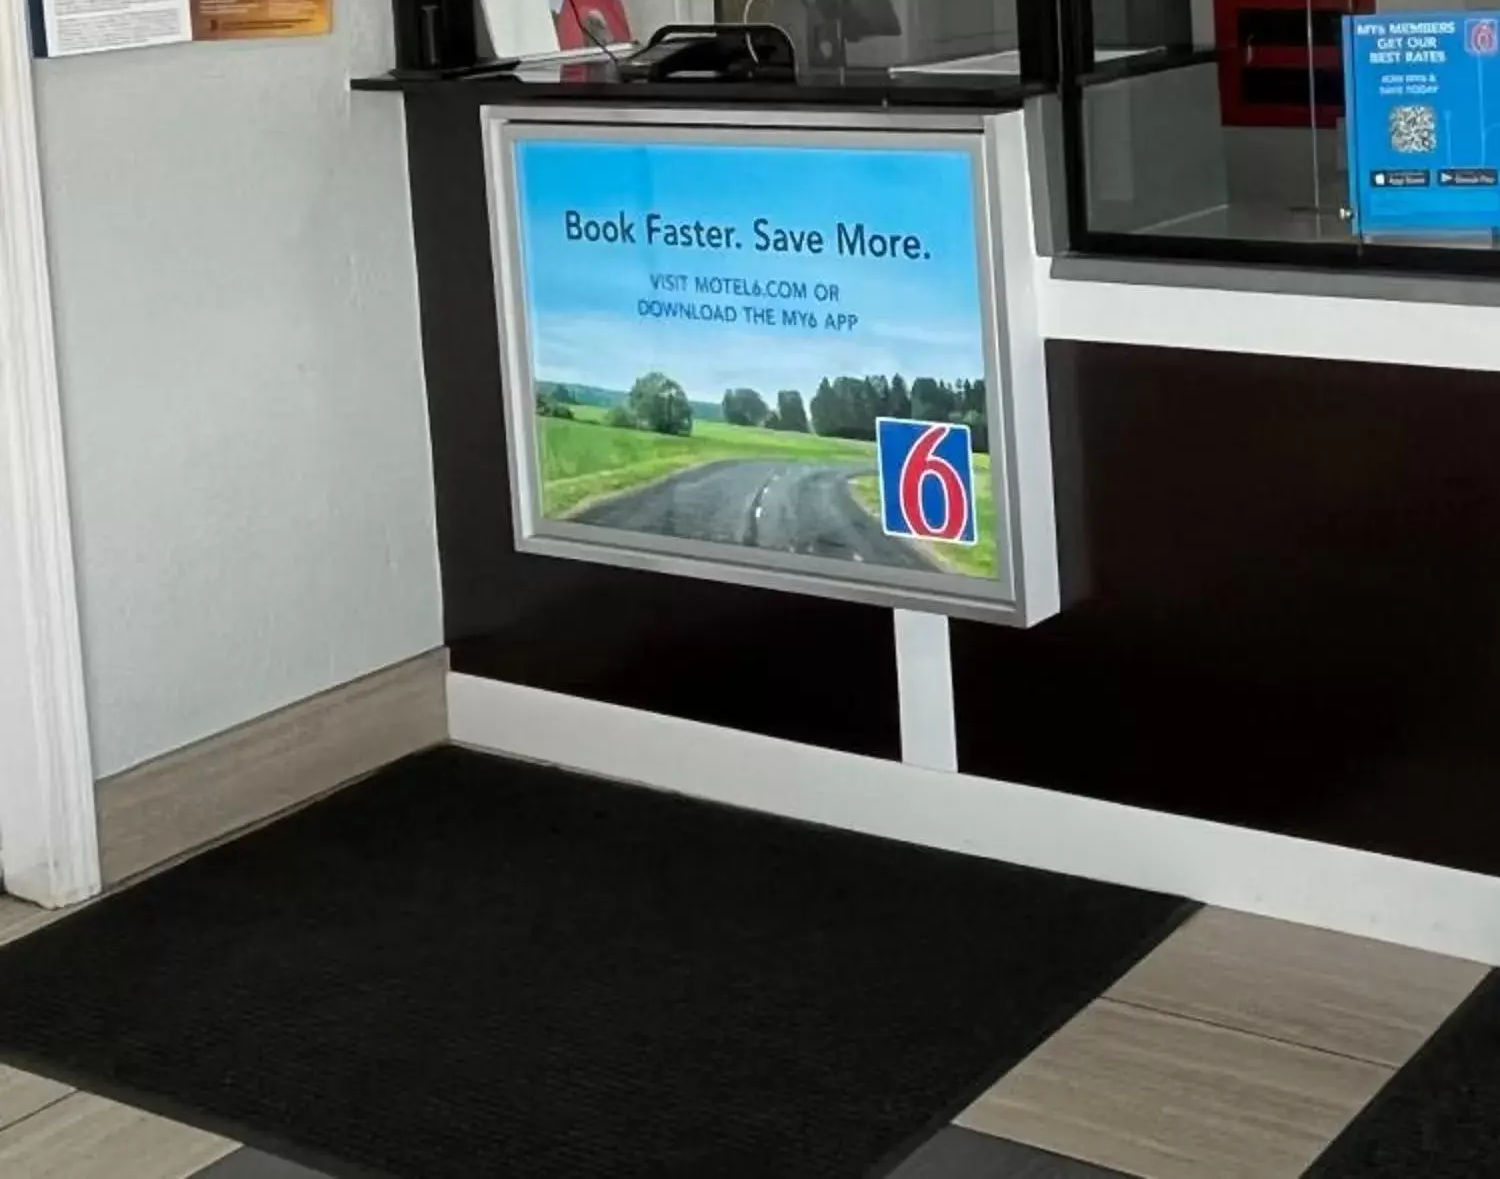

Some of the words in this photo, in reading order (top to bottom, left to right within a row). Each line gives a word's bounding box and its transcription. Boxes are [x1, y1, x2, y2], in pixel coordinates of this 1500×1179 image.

[1377, 38, 1402, 50] GET
[1407, 37, 1438, 49] OUR
[1471, 21, 1494, 52] 6
[1369, 52, 1401, 64] BEST
[1405, 51, 1447, 63] RATES
[564, 210, 636, 245] Book
[645, 213, 742, 250] Faster.
[753, 218, 824, 254] Save
[836, 222, 931, 260] More.
[650, 273, 688, 292] VISIT
[695, 275, 807, 301] MOTEL6.COM
[813, 283, 840, 302] OR
[637, 299, 738, 324] DOWNLOAD
[743, 306, 776, 326] THE
[781, 310, 818, 329] MY6
[823, 313, 859, 332] APP
[899, 422, 969, 540] 6
